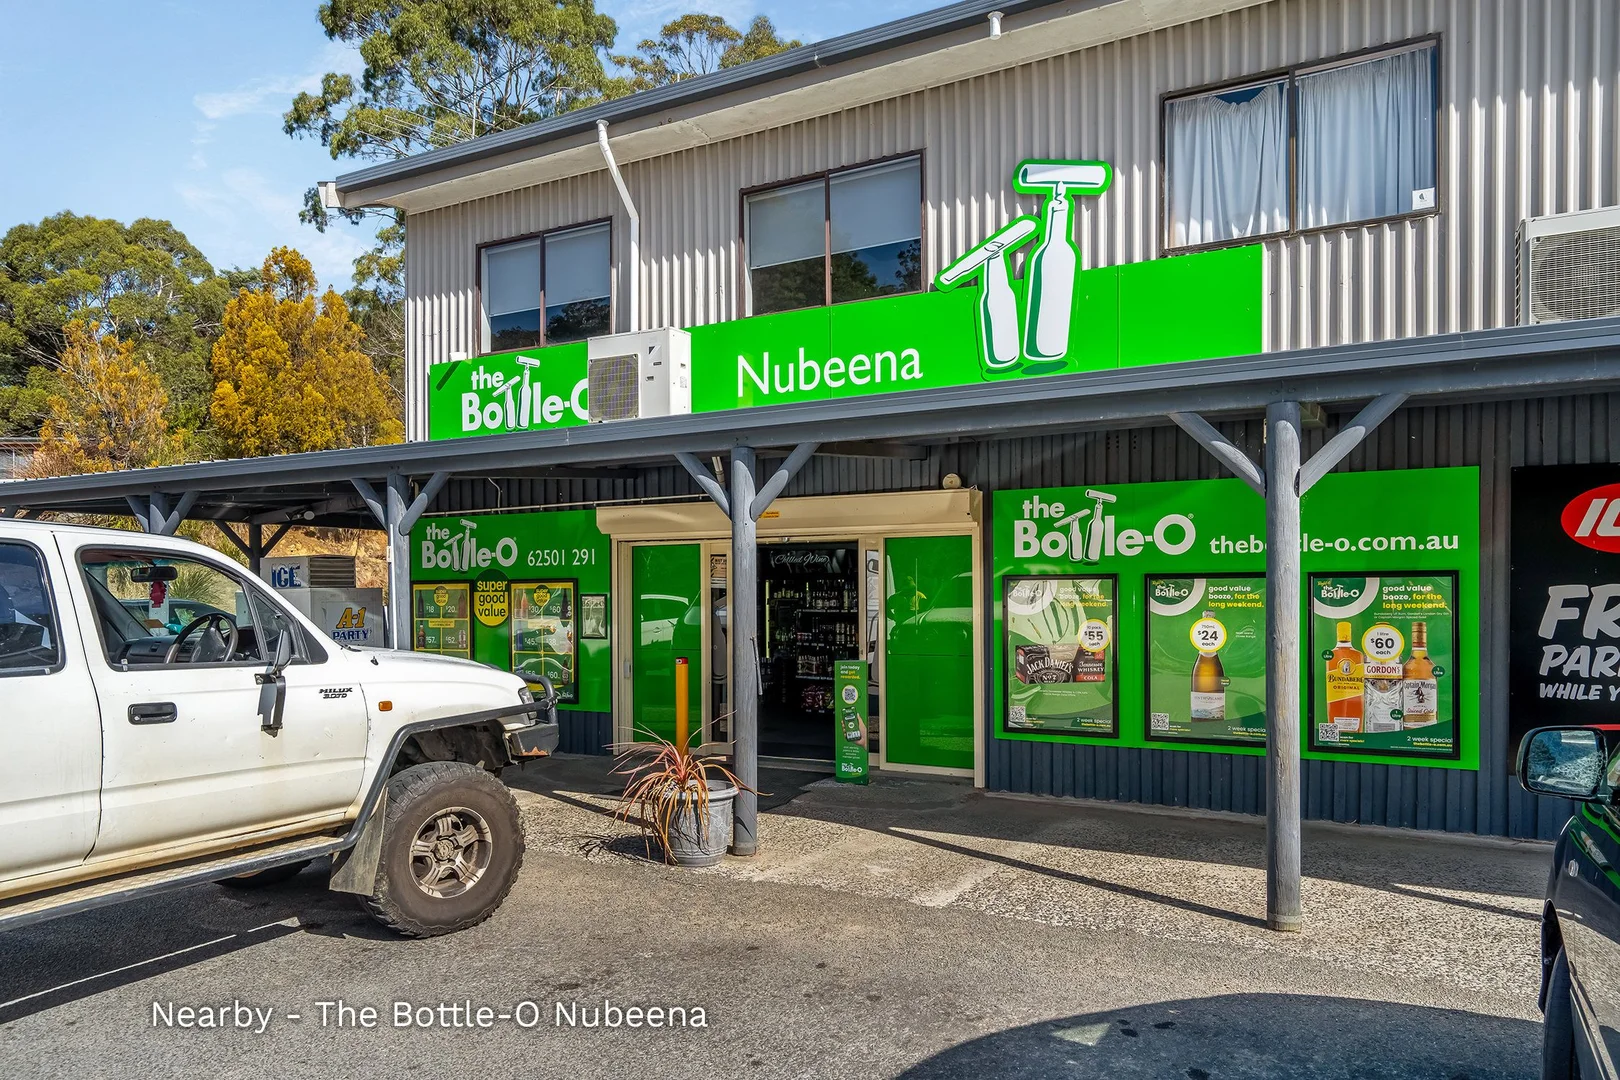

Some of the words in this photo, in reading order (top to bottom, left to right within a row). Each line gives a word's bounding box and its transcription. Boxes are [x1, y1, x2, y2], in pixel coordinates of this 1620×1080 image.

[471, 366, 504, 390] the
[738, 347, 923, 398] Nubeena
[1022, 495, 1065, 519] the
[426, 523, 450, 541] the
[1014, 489, 1197, 562] Bottle-O
[422, 519, 518, 572] Bottle-O
[527, 549, 566, 567] 62501
[572, 548, 596, 566] 291
[476, 580, 508, 596] super
[1382, 592, 1411, 600] booze,
[1425, 592, 1442, 600] the
[1406, 584, 1432, 592] value
[479, 593, 506, 605] good
[1208, 601, 1225, 609] long
[1382, 602, 1403, 610] long
[336, 607, 366, 629] A-1
[478, 602, 506, 618] value
[333, 630, 369, 640] PARTY
[1084, 631, 1104, 641] $55
[1198, 630, 1218, 641] $24
[1371, 638, 1395, 649] $60
[1026, 659, 1045, 674] JACK
[1044, 656, 1074, 674] DANIEL'S
[1539, 644, 1620, 677] PAR
[1366, 665, 1400, 674] GORDON'S
[1539, 682, 1602, 700] WHILE
